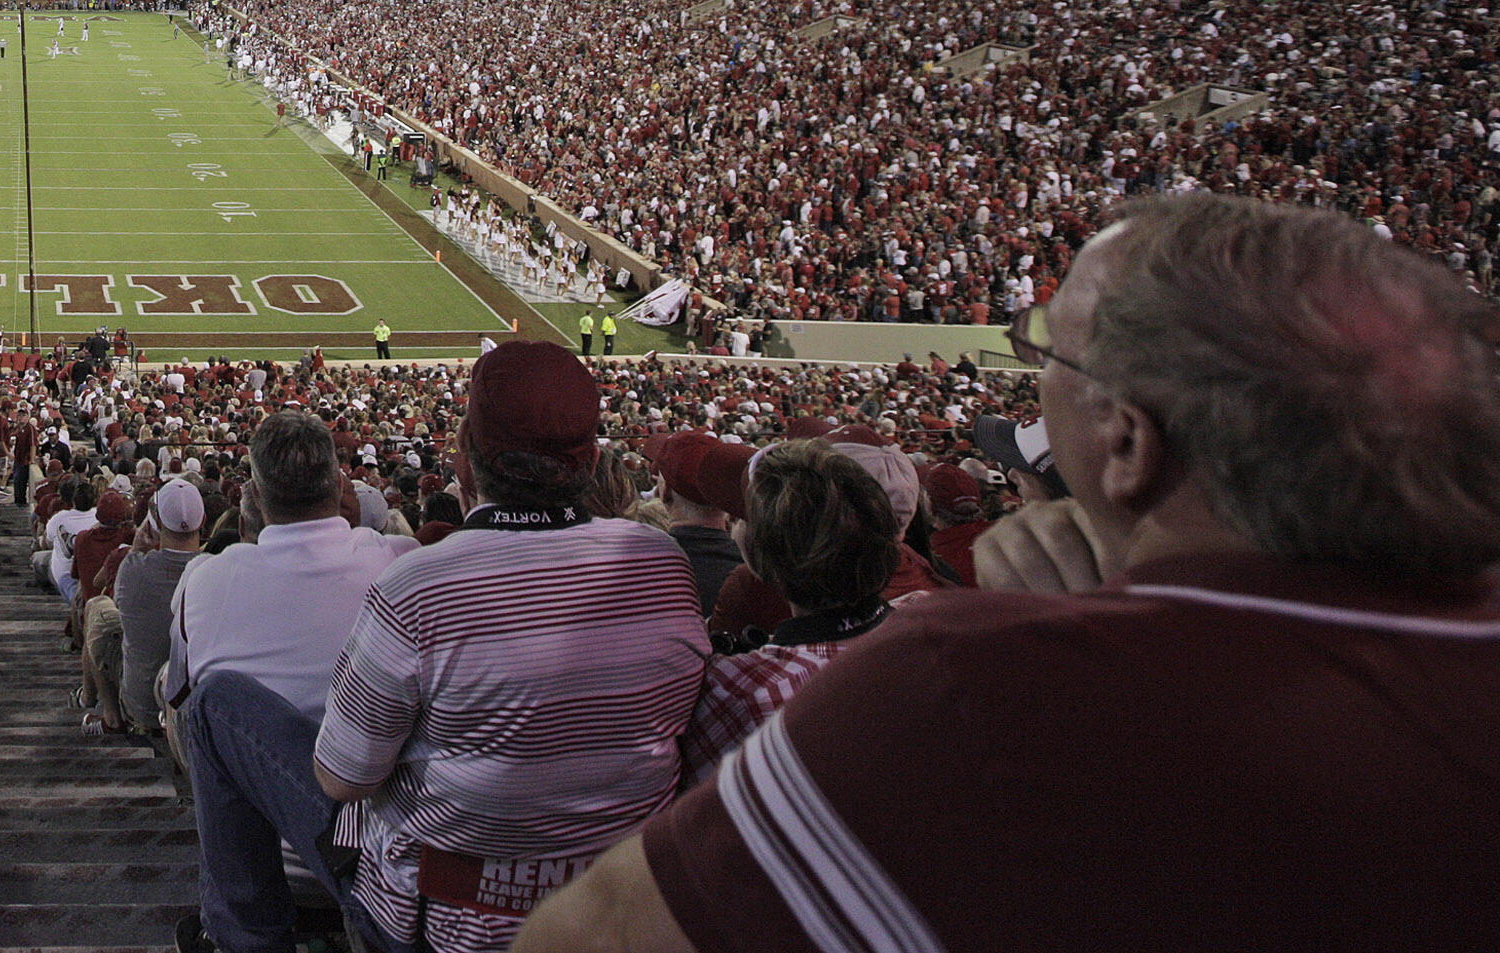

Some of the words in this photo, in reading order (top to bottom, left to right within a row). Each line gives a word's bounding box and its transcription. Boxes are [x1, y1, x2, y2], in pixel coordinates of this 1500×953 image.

[186, 161, 229, 179] 20
[211, 200, 259, 219] 10
[493, 511, 552, 524] VORTEX
[480, 878, 534, 898] LEAVE
